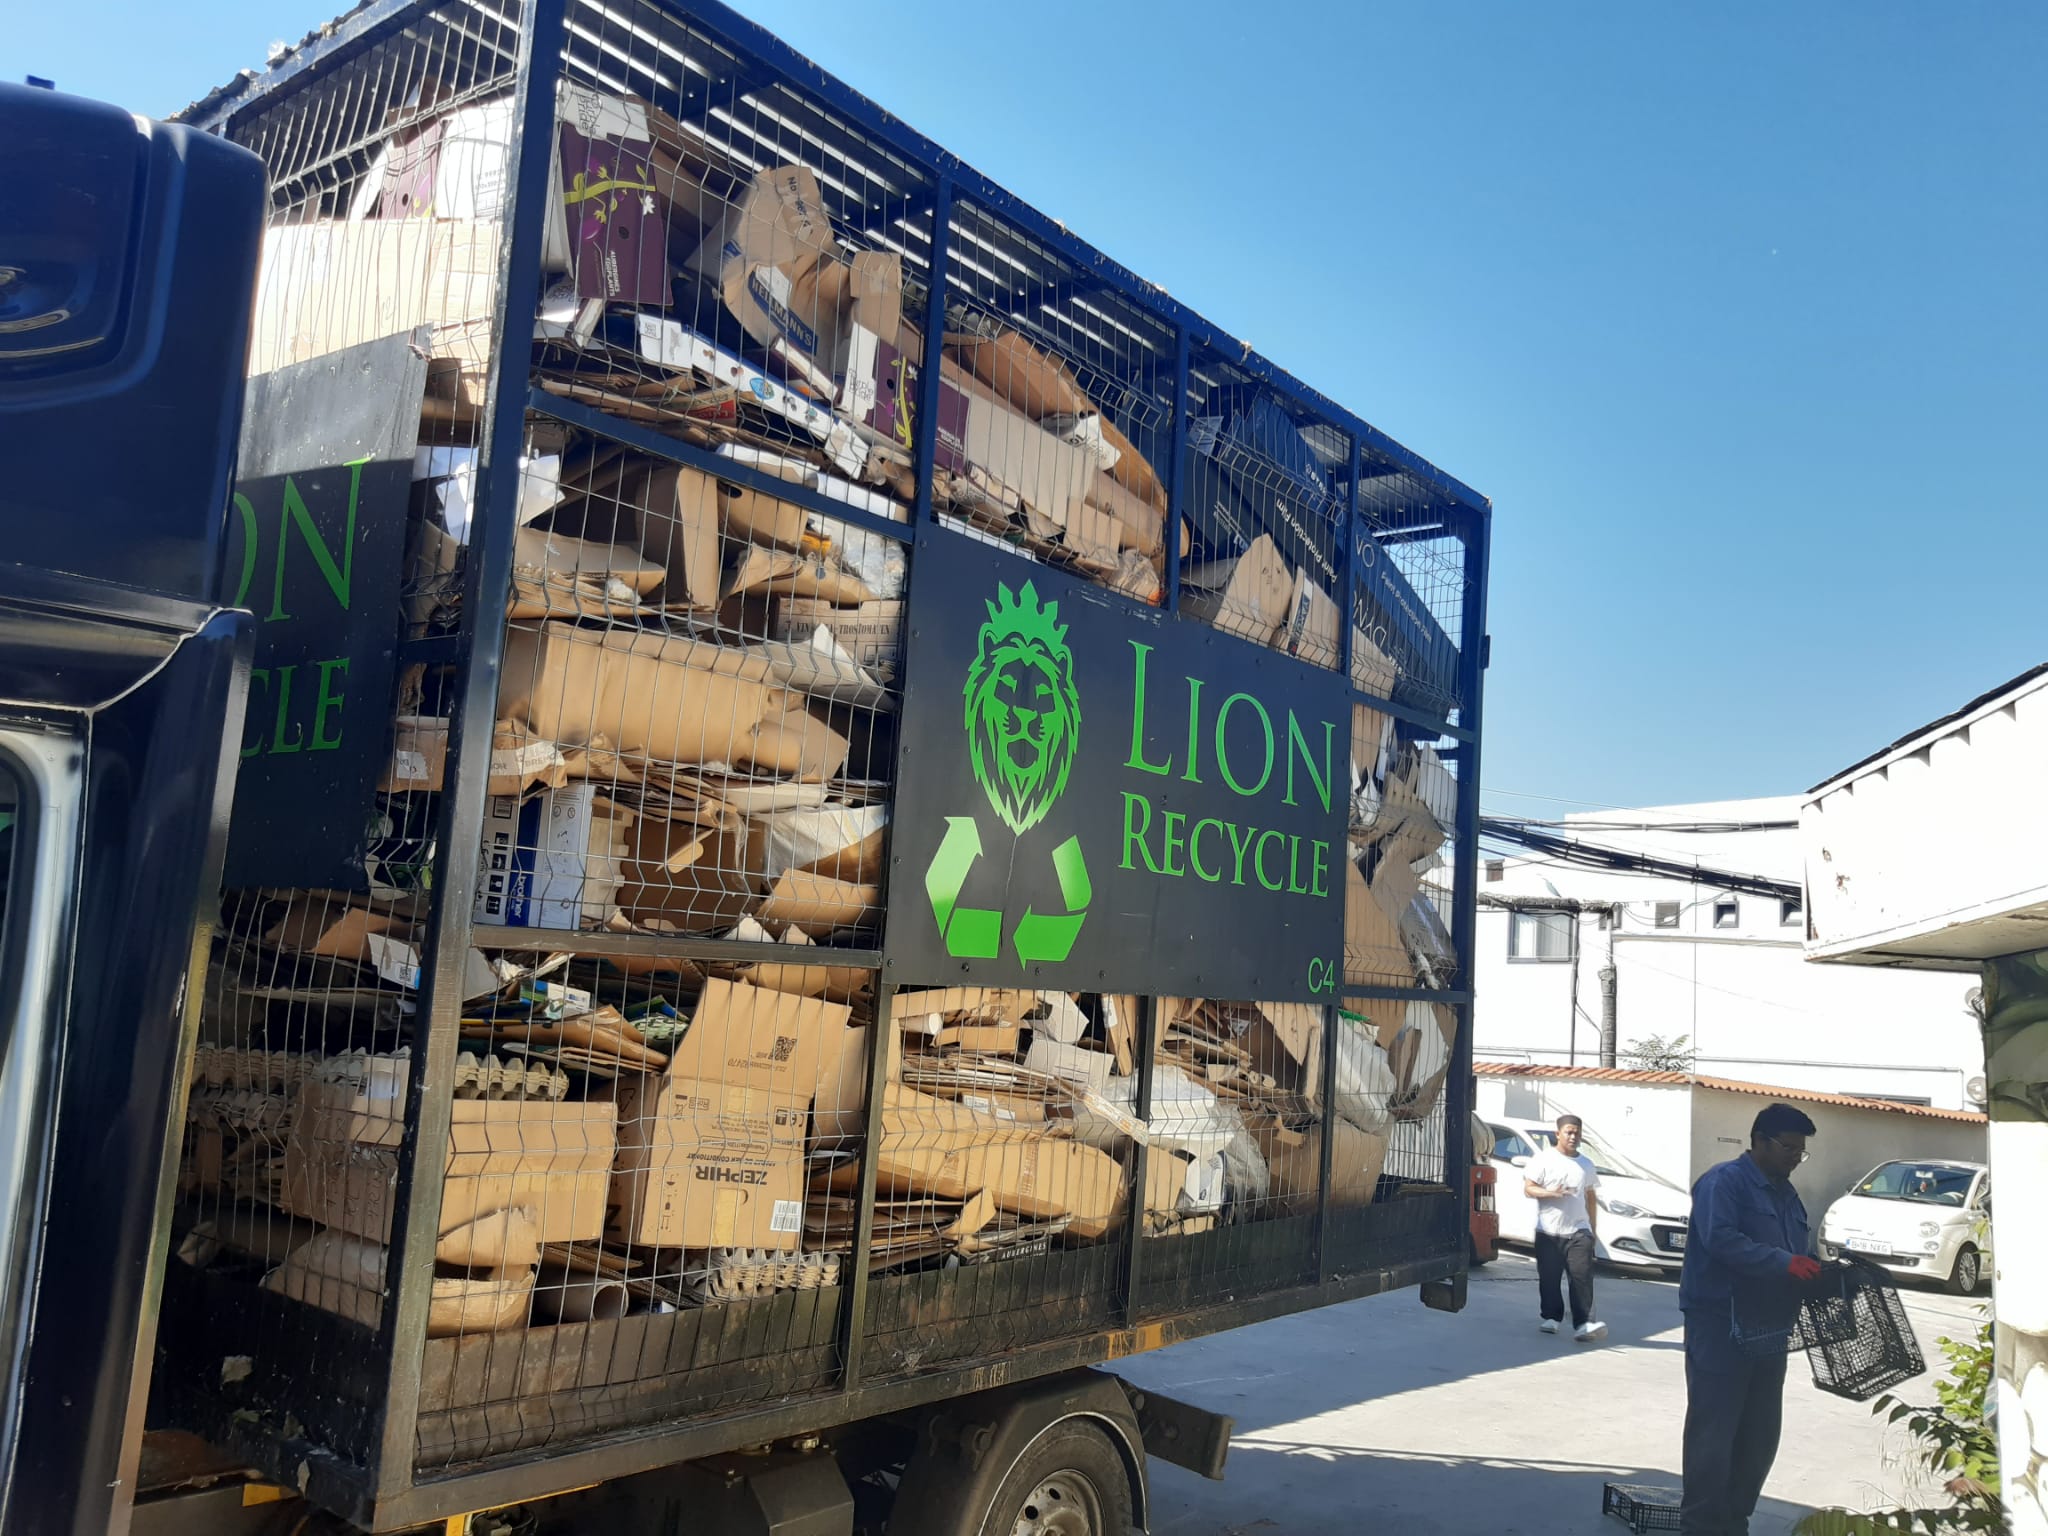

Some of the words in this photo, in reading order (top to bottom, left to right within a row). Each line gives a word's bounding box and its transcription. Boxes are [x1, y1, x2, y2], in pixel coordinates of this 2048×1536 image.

[1291, 517, 1323, 563] Protection
[1123, 640, 1337, 816] LION
[1119, 791, 1330, 898] RECYCLE
[513, 875, 528, 919] brother
[1307, 957, 1335, 994] C4
[695, 1165, 768, 1185] ZEPHIR
[1001, 1241, 1047, 1259] AUBERGINES
